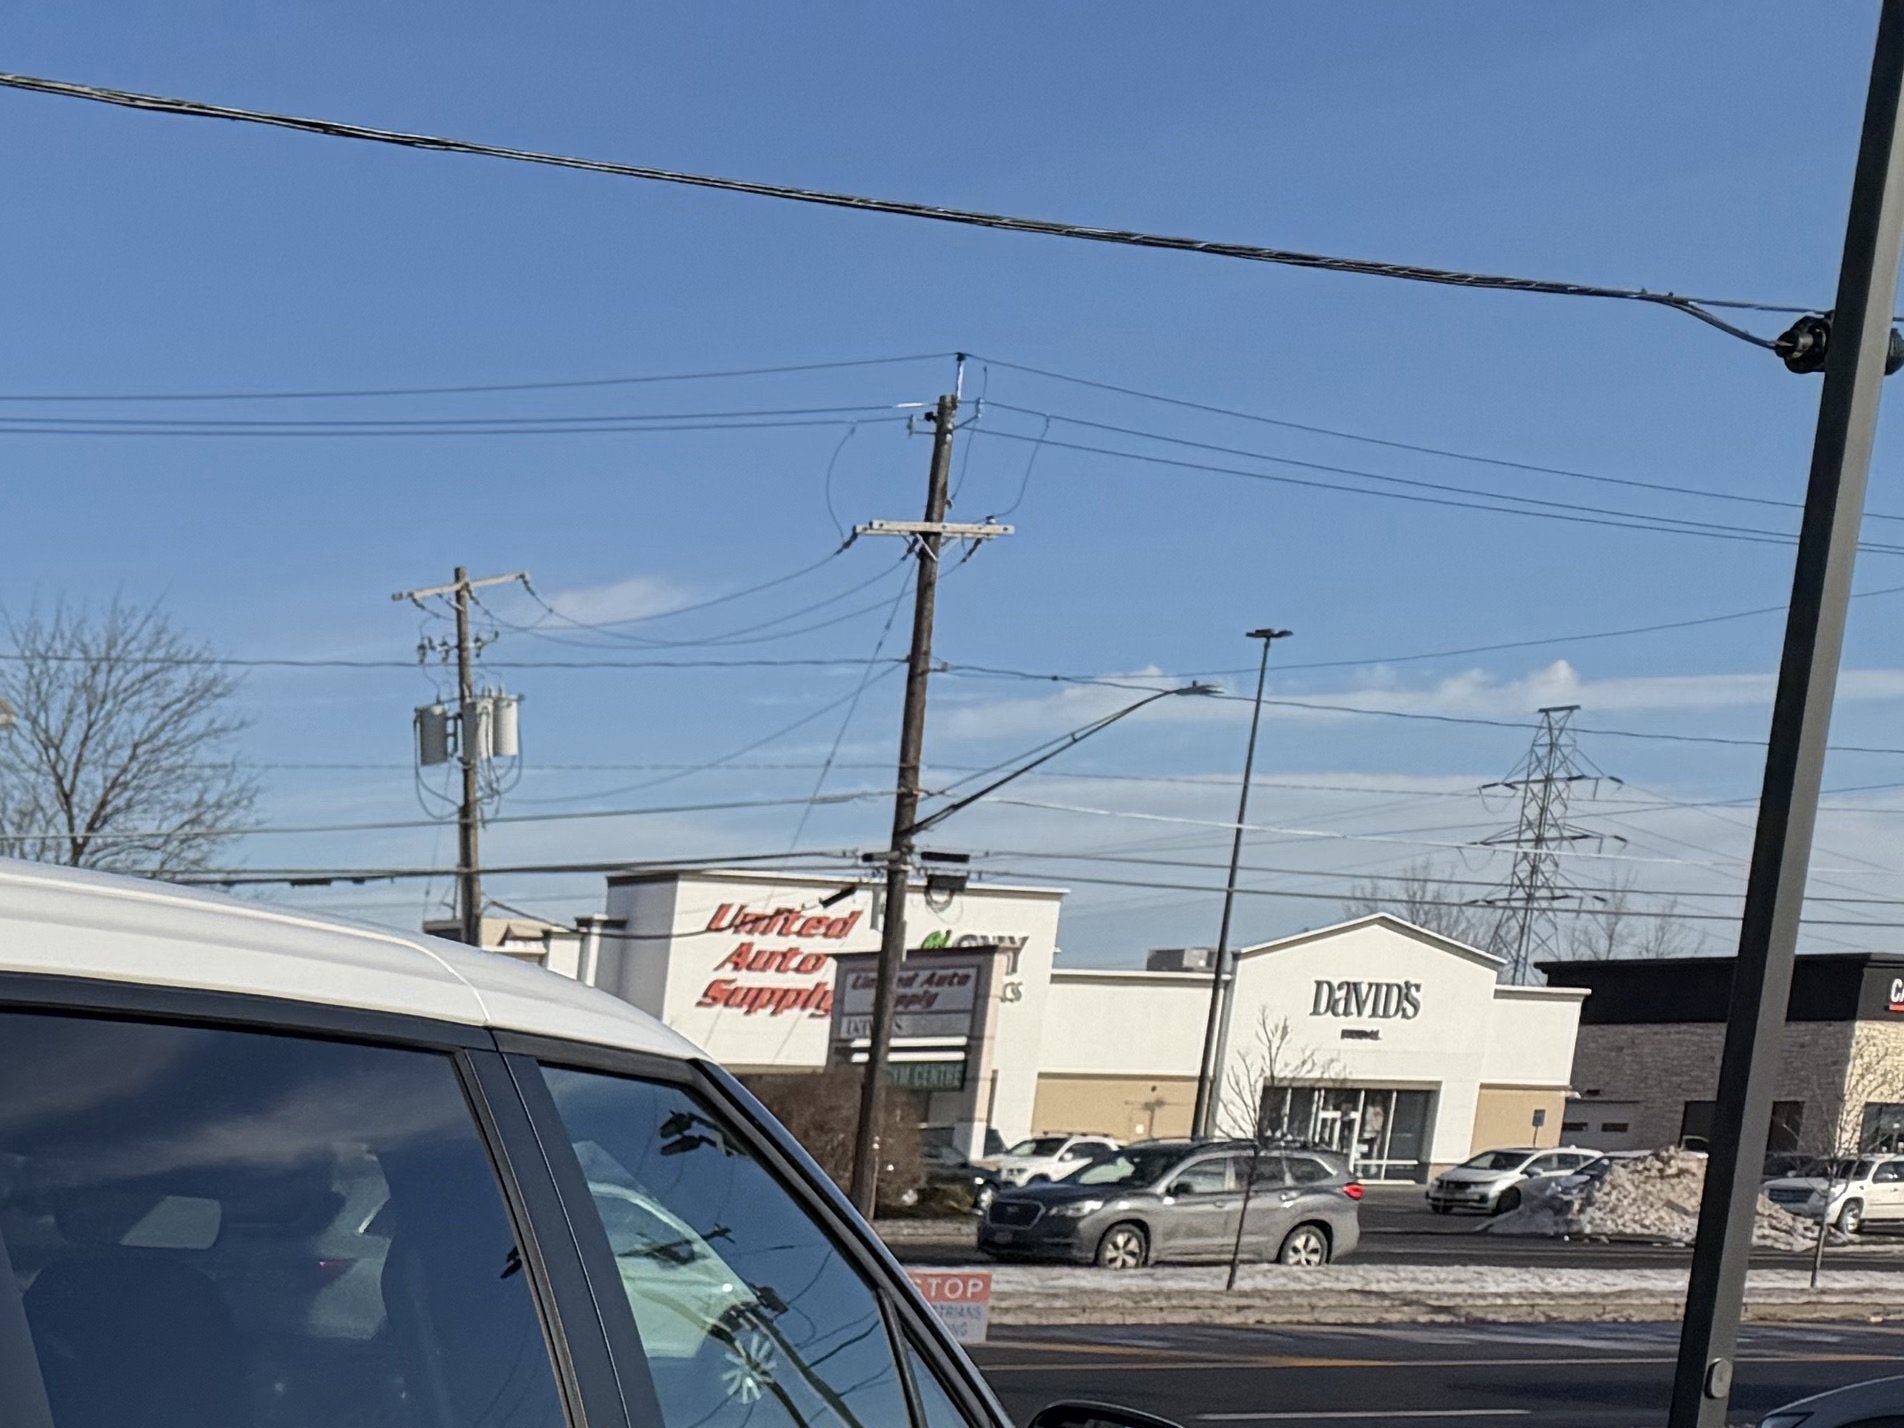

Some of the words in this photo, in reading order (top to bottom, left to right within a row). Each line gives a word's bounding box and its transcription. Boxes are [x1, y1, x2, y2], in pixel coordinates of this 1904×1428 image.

[706, 903, 864, 940] United
[713, 942, 828, 974] Auto
[919, 971, 973, 988] Auto
[695, 978, 834, 1018] Supply
